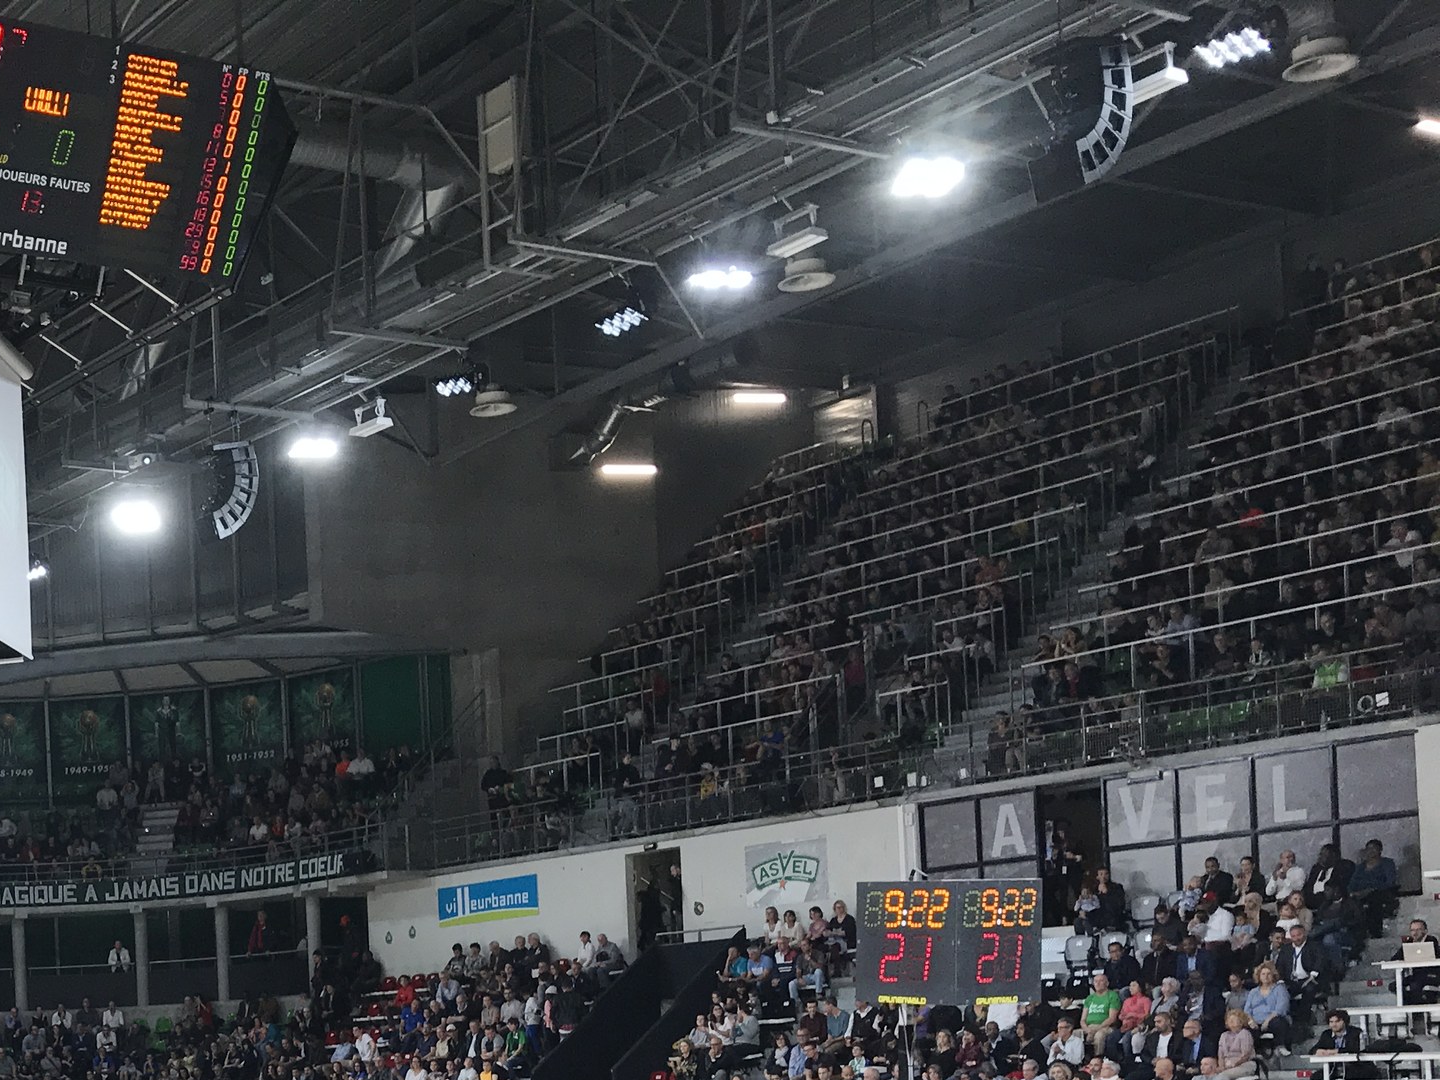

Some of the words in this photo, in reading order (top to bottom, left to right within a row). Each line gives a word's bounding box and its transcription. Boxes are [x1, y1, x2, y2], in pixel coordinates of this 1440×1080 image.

[238, 68, 248, 76] FP
[256, 71, 270, 81] PTS
[52, 129, 75, 165] 0
[213, 123, 223, 138] 8
[50, 178, 91, 194] FAUTES
[85, 883, 98, 902] A
[105, 876, 180, 901] JAMAIS
[185, 870, 236, 894] DANS
[241, 861, 295, 888] NOTRE
[760, 850, 812, 880] ASVEL
[446, 885, 529, 915] villeurbanne
[884, 887, 950, 929] 9:22
[982, 887, 1038, 928] 9:22
[879, 933, 933, 984] 21
[976, 933, 1024, 984] 21
